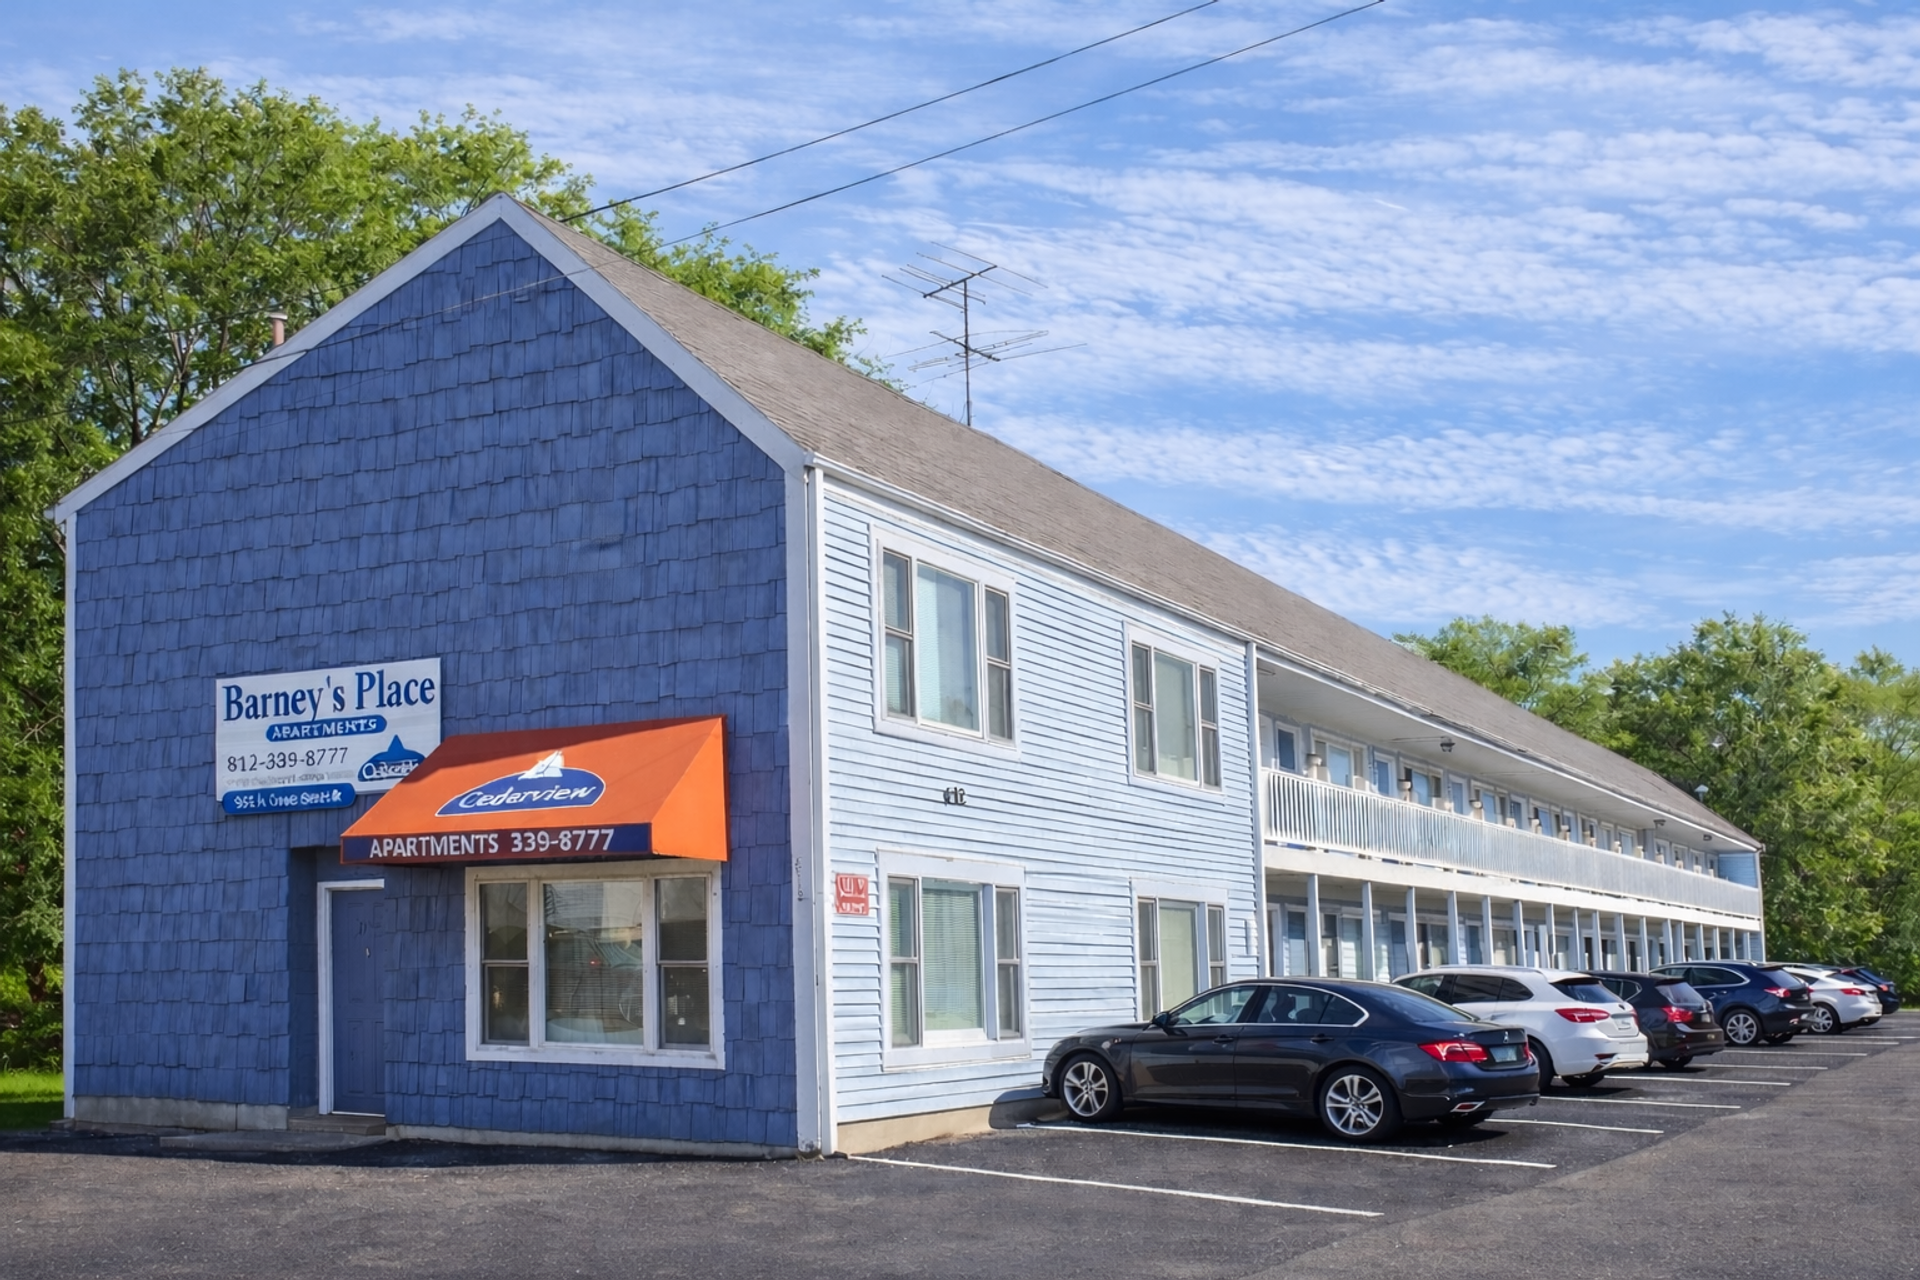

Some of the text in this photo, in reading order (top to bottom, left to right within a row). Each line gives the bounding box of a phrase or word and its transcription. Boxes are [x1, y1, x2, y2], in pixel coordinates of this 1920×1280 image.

[222, 669, 436, 722] Barney's Place
[272, 718, 377, 740] APARTMENTS
[227, 746, 348, 773] 812-339-8777
[458, 784, 597, 809] Cedarview
[369, 828, 615, 859] APARTMENTS 339-8777
